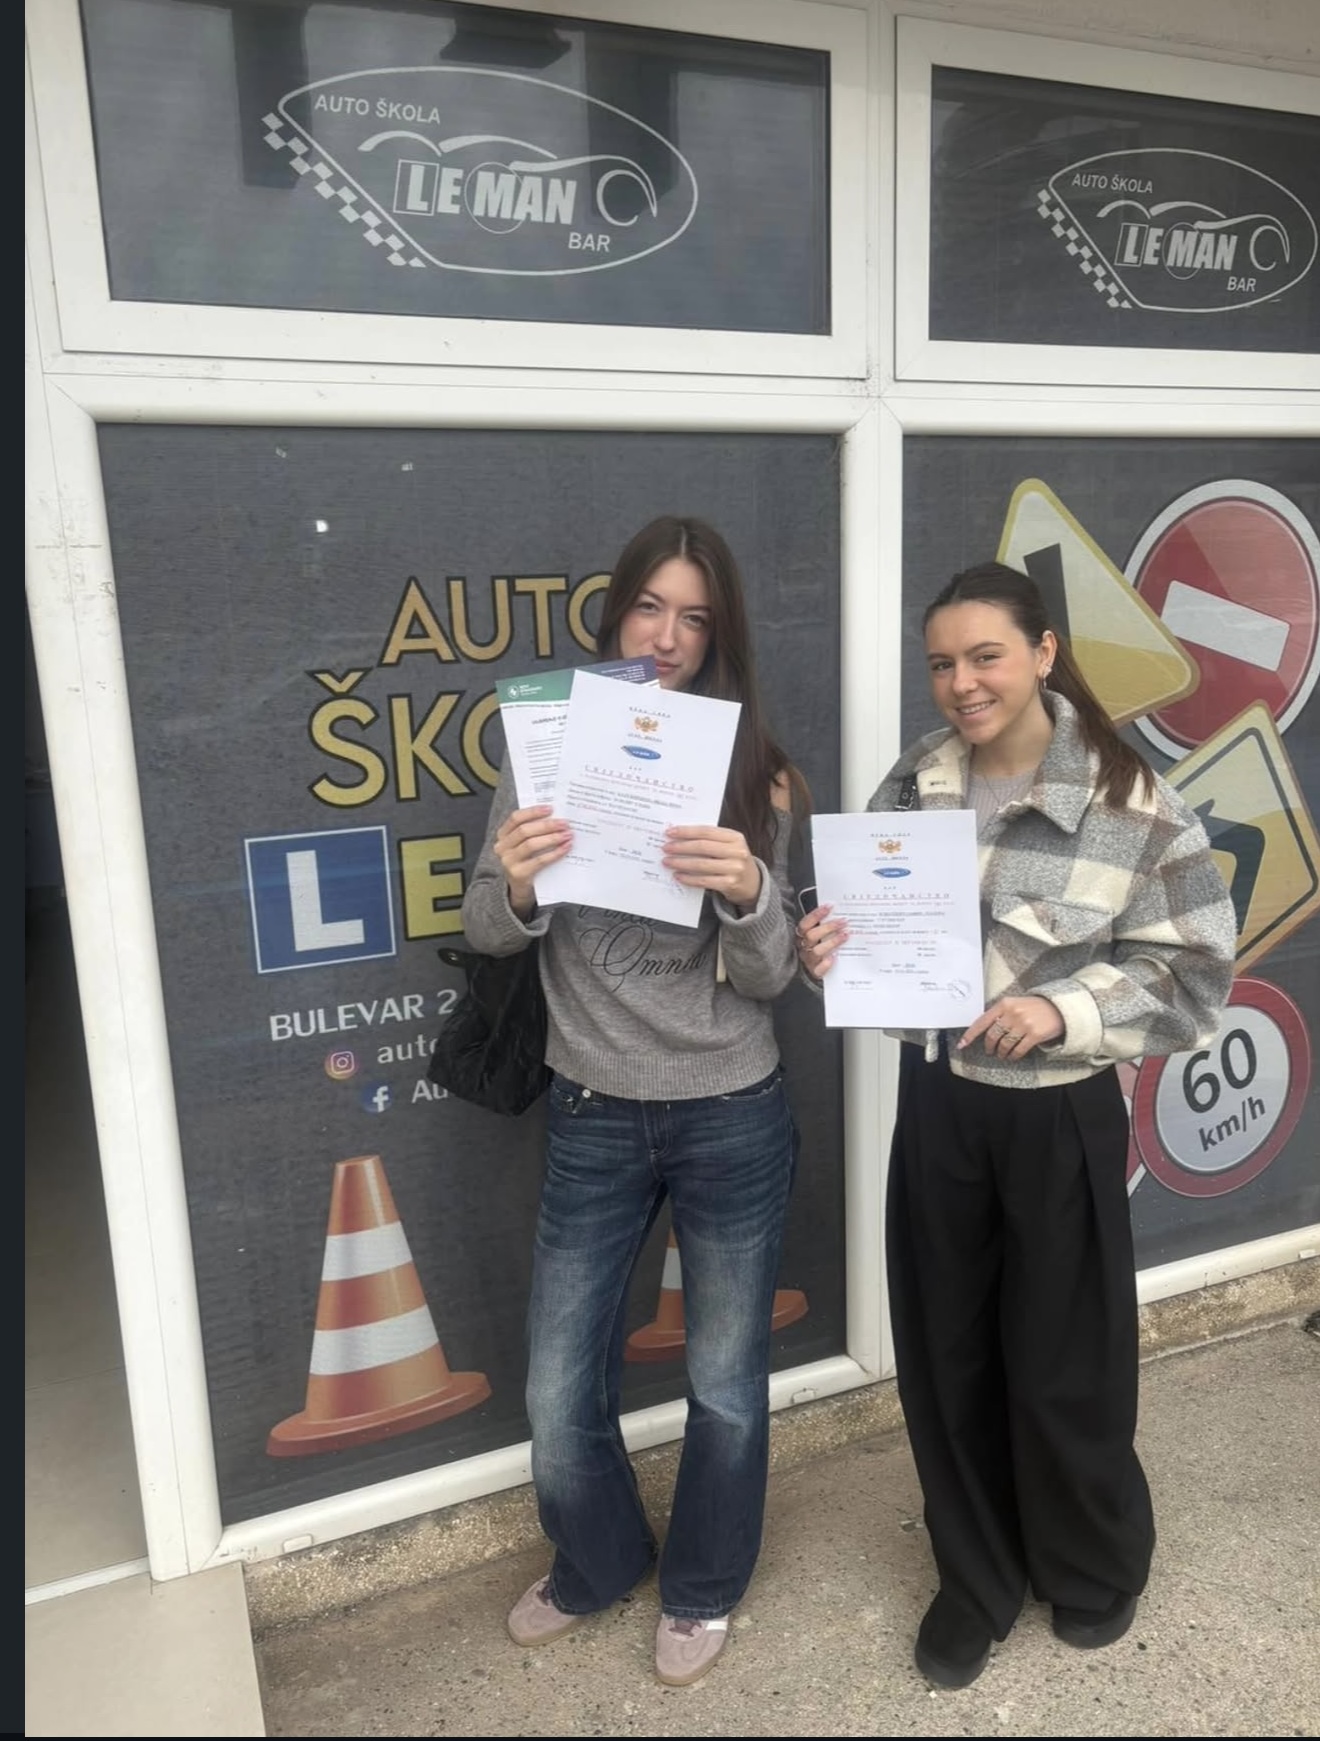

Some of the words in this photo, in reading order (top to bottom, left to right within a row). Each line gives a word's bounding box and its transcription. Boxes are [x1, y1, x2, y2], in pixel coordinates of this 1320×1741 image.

[314, 93, 370, 117] AUTO
[375, 97, 441, 125] ŠKOLA
[1071, 173, 1108, 190] AUTO
[1110, 173, 1153, 194] ŠKOLA
[568, 232, 611, 253] BAR
[1226, 276, 1257, 293] BAR
[269, 993, 425, 1042] BULEVAR
[1182, 1028, 1258, 1114] 60
[1198, 1096, 1266, 1152] km/h
